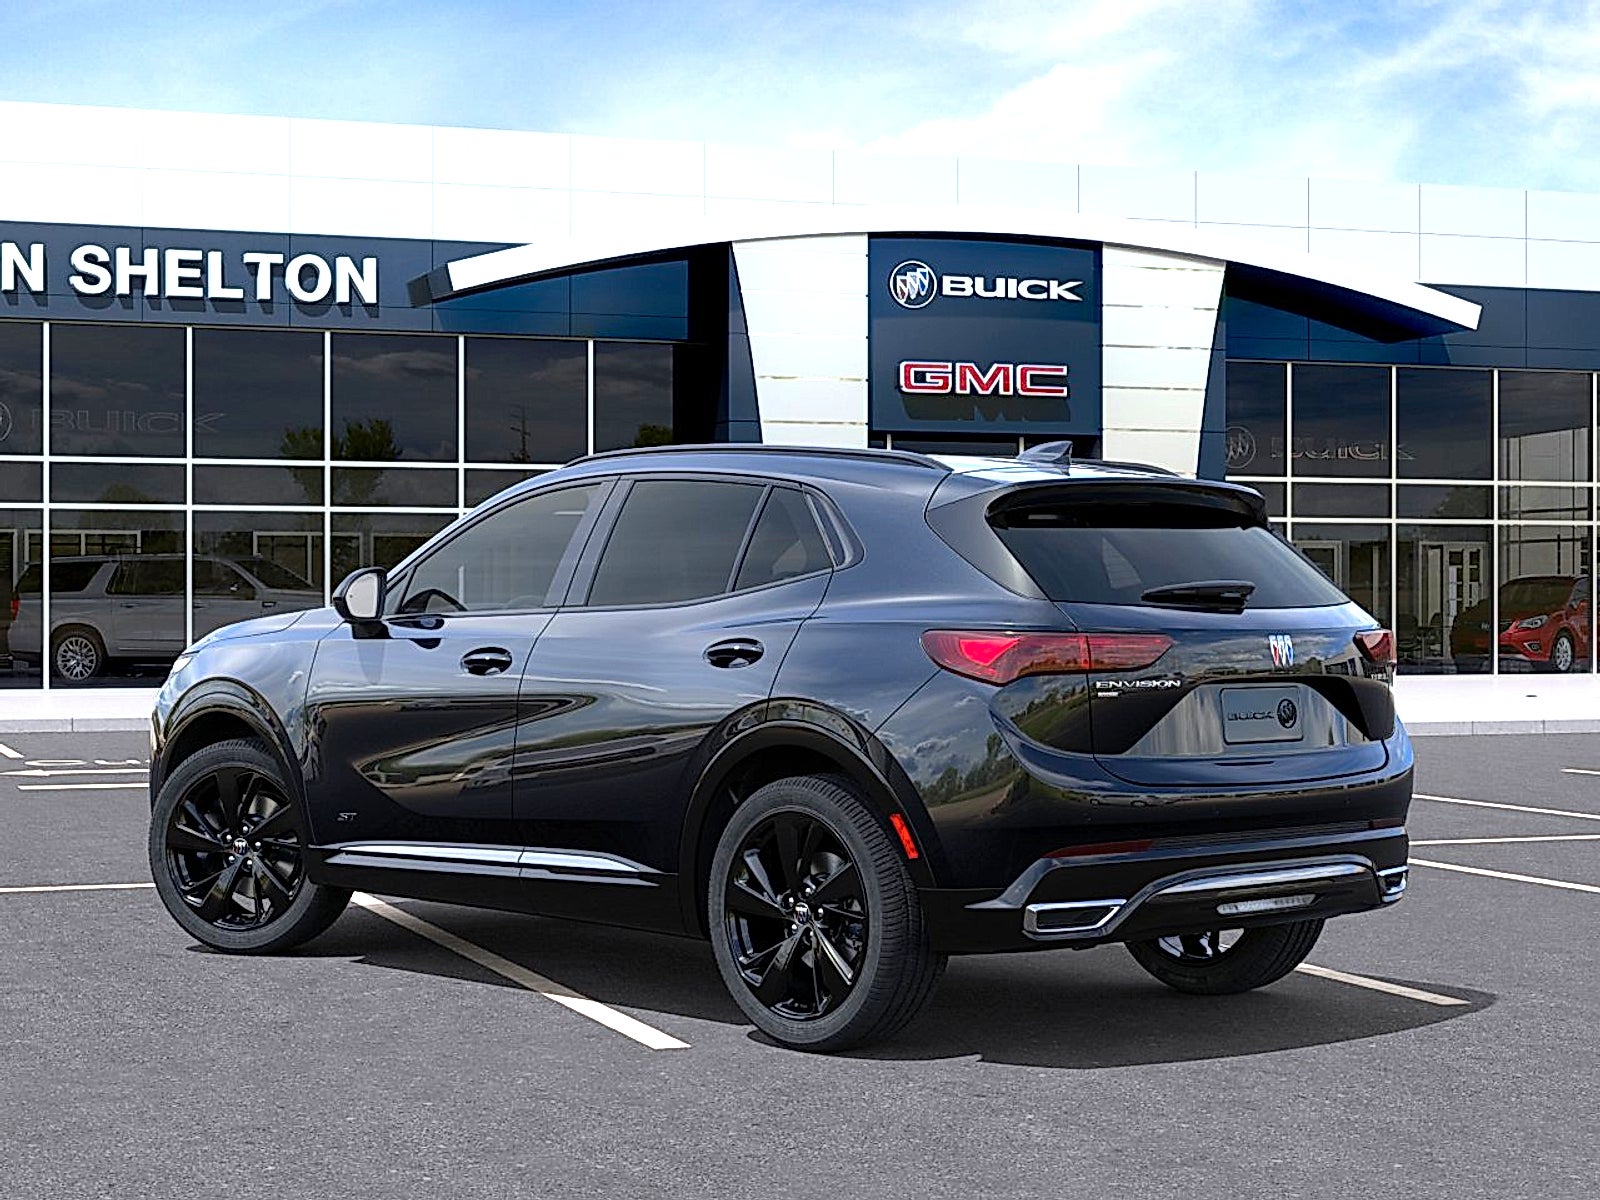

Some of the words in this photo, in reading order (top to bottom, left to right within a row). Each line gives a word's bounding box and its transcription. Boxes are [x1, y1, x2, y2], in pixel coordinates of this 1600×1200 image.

[69, 244, 377, 304] SHELTON
[941, 275, 1084, 301] BUICK
[900, 360, 1068, 397] GMC
[1096, 680, 1181, 688] ENVISION
